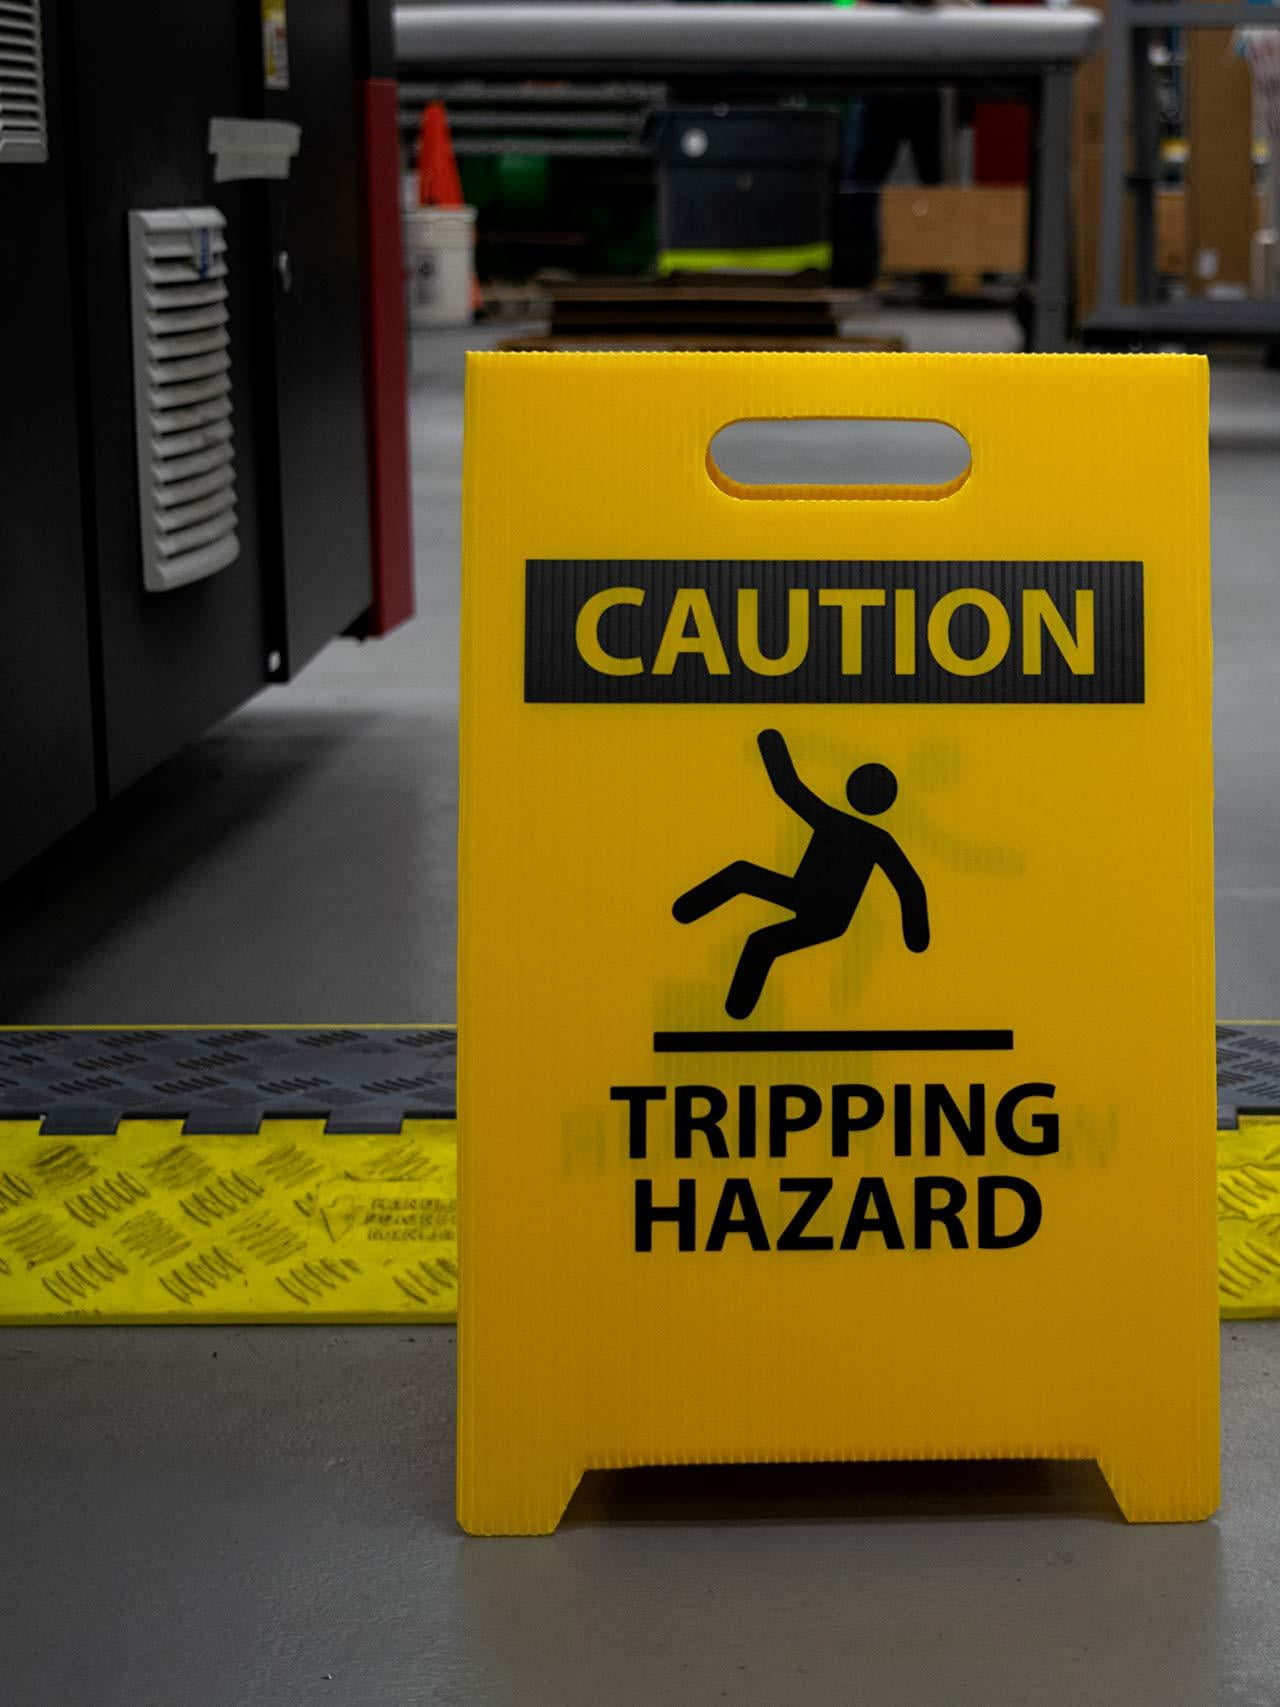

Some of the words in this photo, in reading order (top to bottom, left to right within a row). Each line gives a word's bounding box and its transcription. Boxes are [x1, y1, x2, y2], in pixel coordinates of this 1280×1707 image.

[575, 586, 1095, 676] CAUTION
[609, 1082, 1060, 1159] TRIPPING
[633, 1175, 1043, 1252] HAZARD
